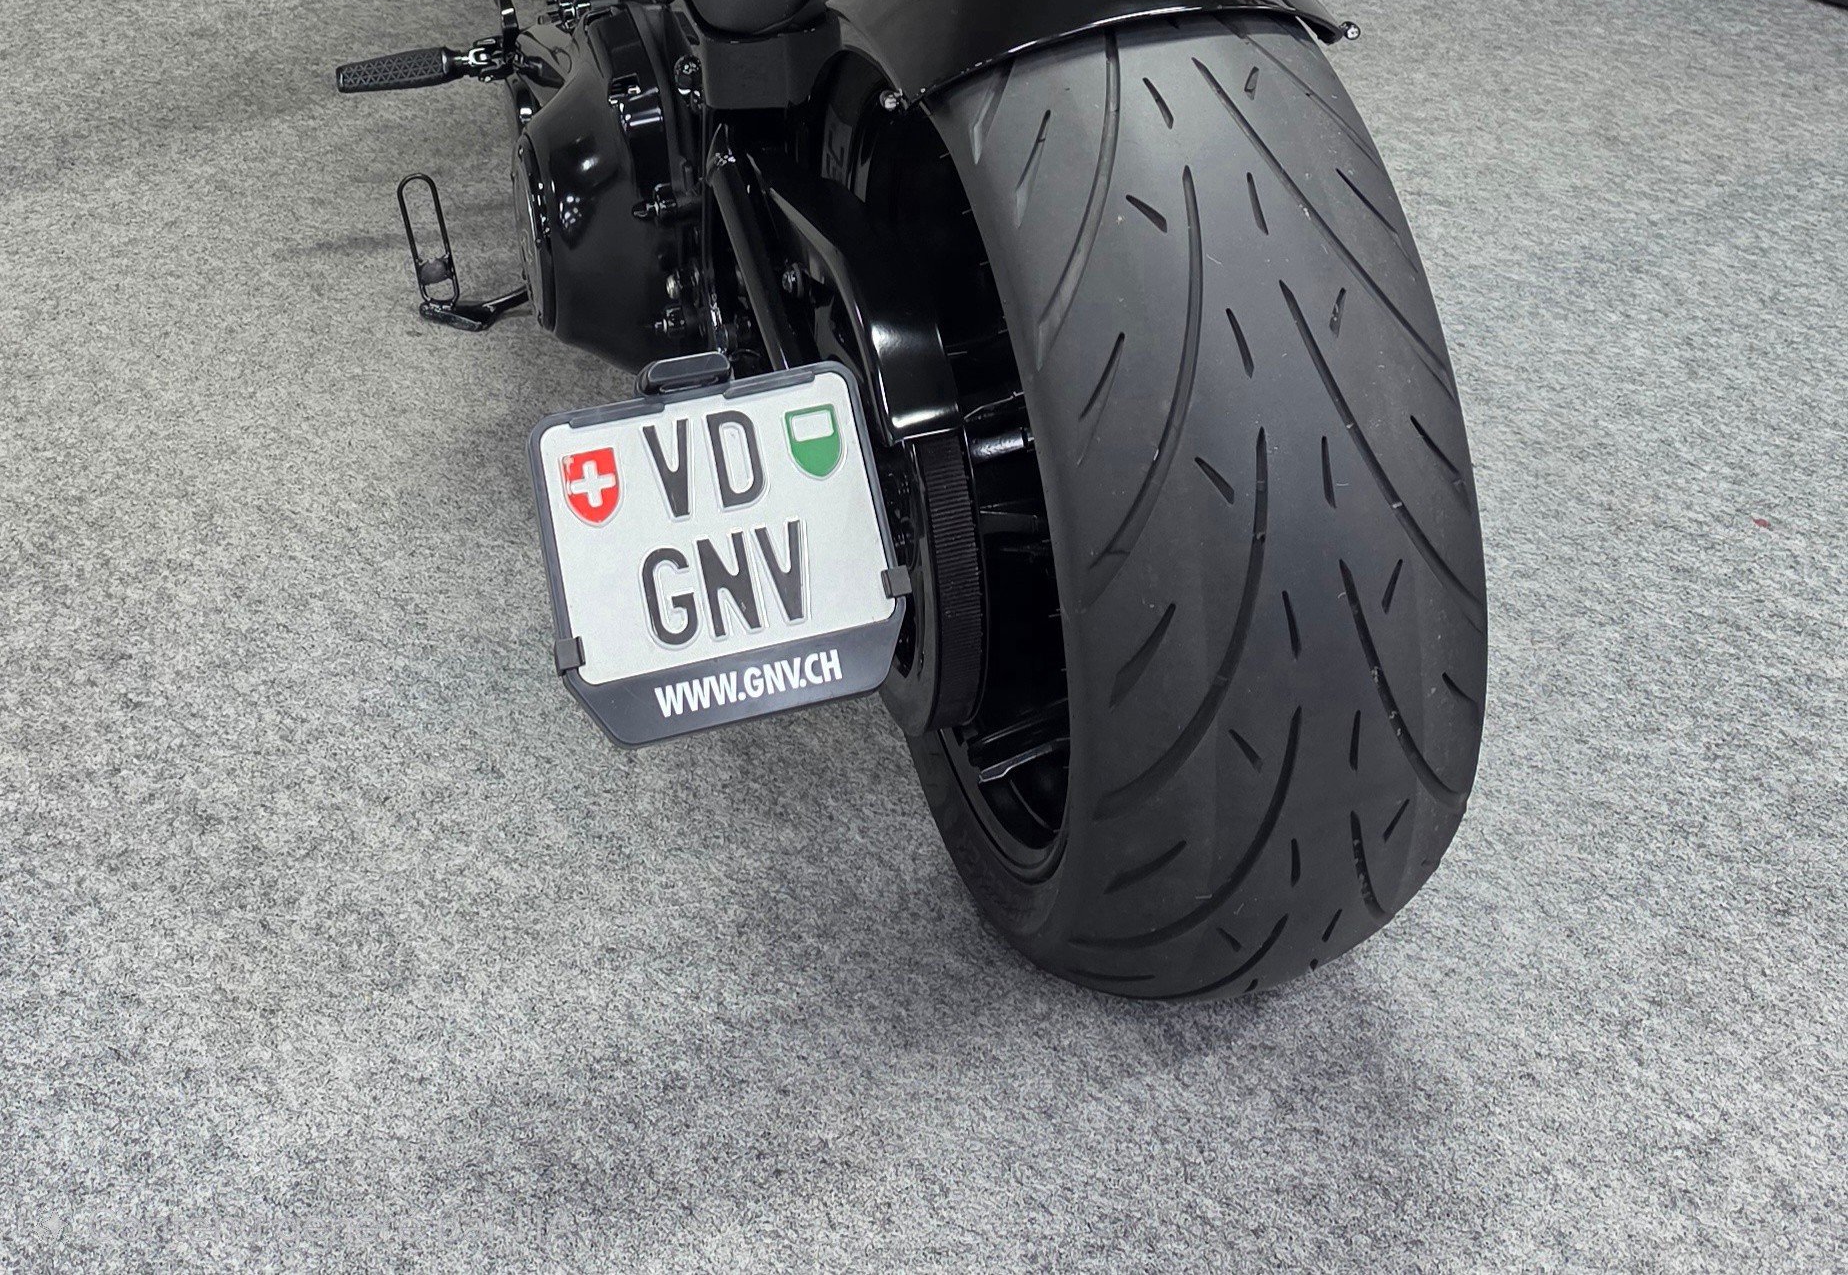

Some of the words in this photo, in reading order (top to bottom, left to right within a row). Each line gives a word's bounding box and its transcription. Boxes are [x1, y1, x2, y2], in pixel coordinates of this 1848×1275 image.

[643, 410, 766, 518] VD
[641, 520, 805, 646] GNV
[654, 649, 843, 718] WWW.GNV.CH
